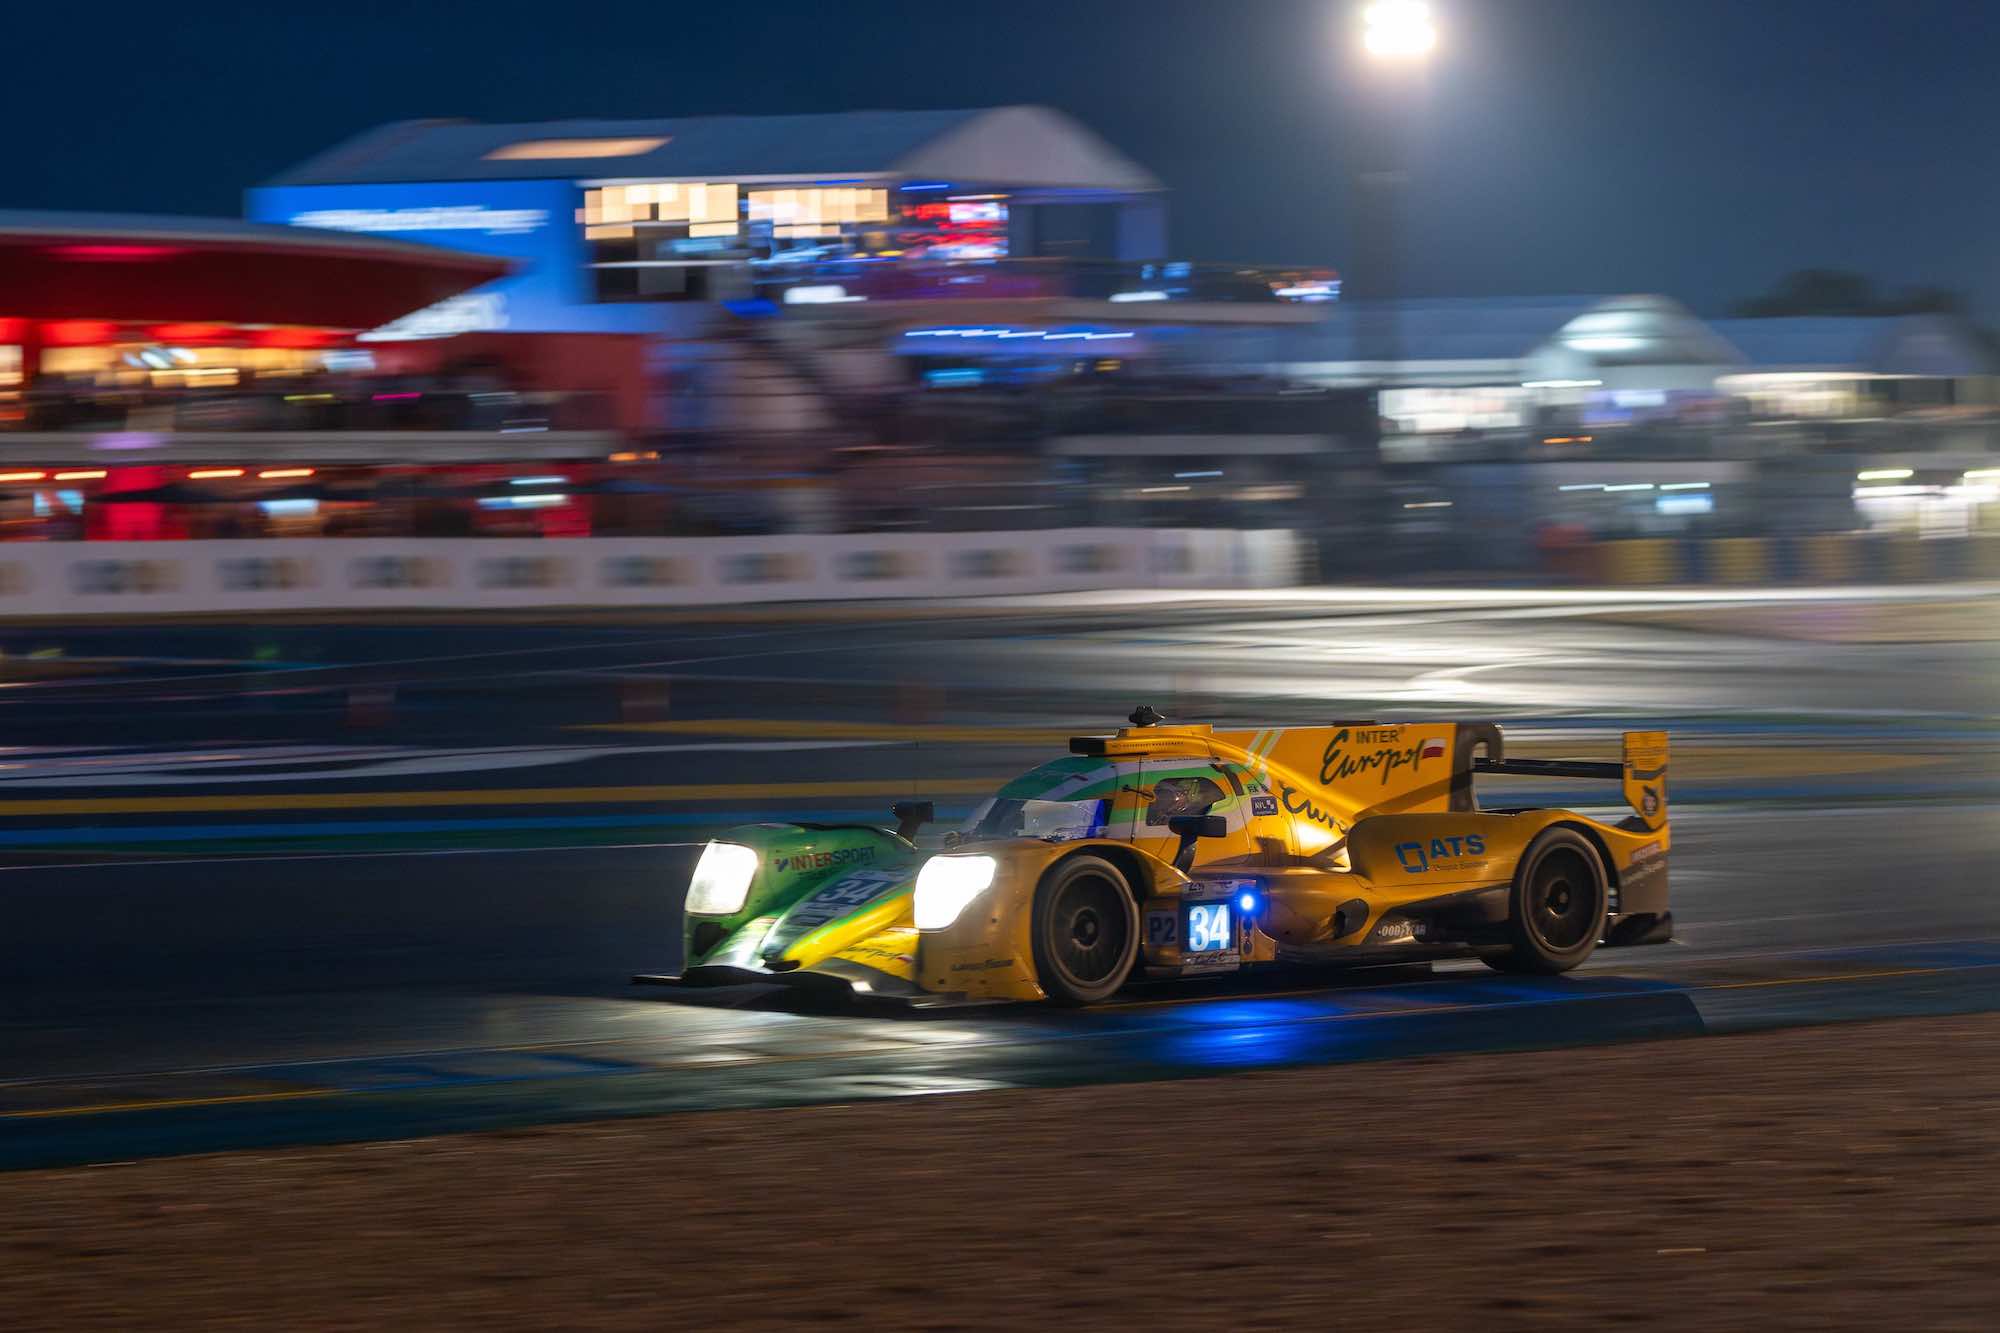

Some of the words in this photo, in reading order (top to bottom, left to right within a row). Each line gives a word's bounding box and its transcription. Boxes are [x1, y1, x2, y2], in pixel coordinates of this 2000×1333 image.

[1356, 730, 1399, 744] INTER
[1319, 729, 1425, 785] Europol
[790, 846, 875, 872] INTERSPORT
[1430, 833, 1486, 860] ATS
[1149, 916, 1176, 945] P2
[1188, 904, 1230, 952] 34
